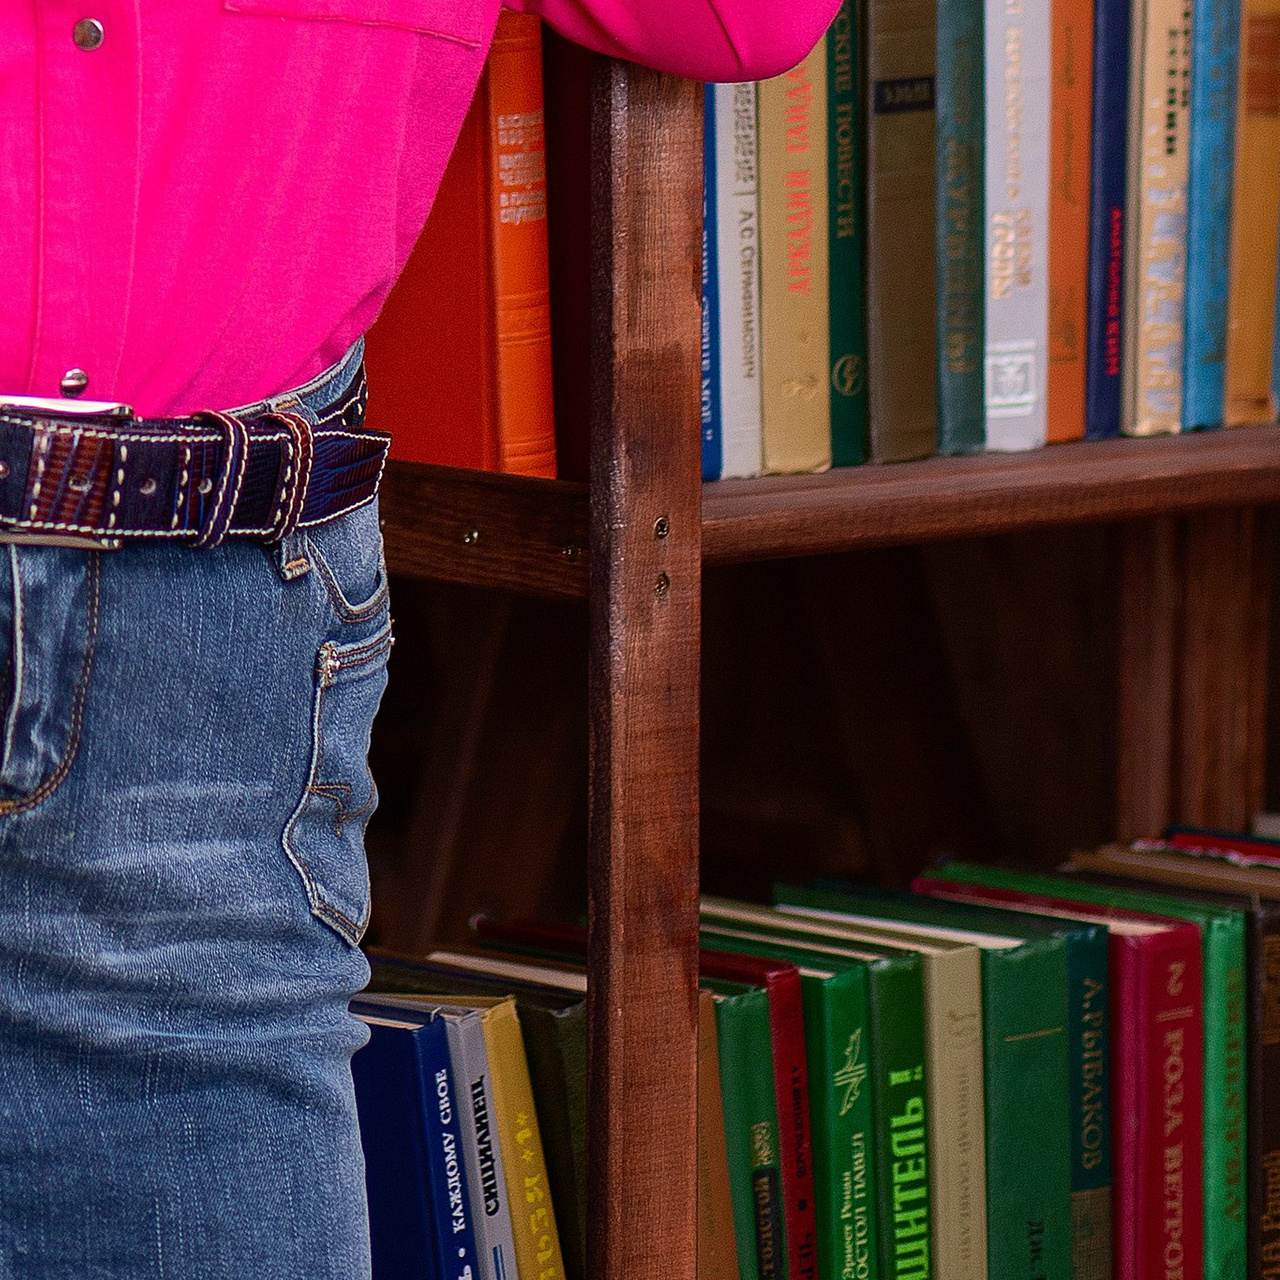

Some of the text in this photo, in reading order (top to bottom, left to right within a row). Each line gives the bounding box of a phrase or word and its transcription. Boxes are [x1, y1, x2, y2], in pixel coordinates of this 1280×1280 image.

[783, 67, 814, 297] АРКАДИЙ ГАЙДА
[435, 1068, 466, 1234] КАЖДОМУ СВОЕ
[471, 1074, 499, 1217] СИЦИЛИЕЦ
[1164, 1027, 1185, 1137] РОЗА
